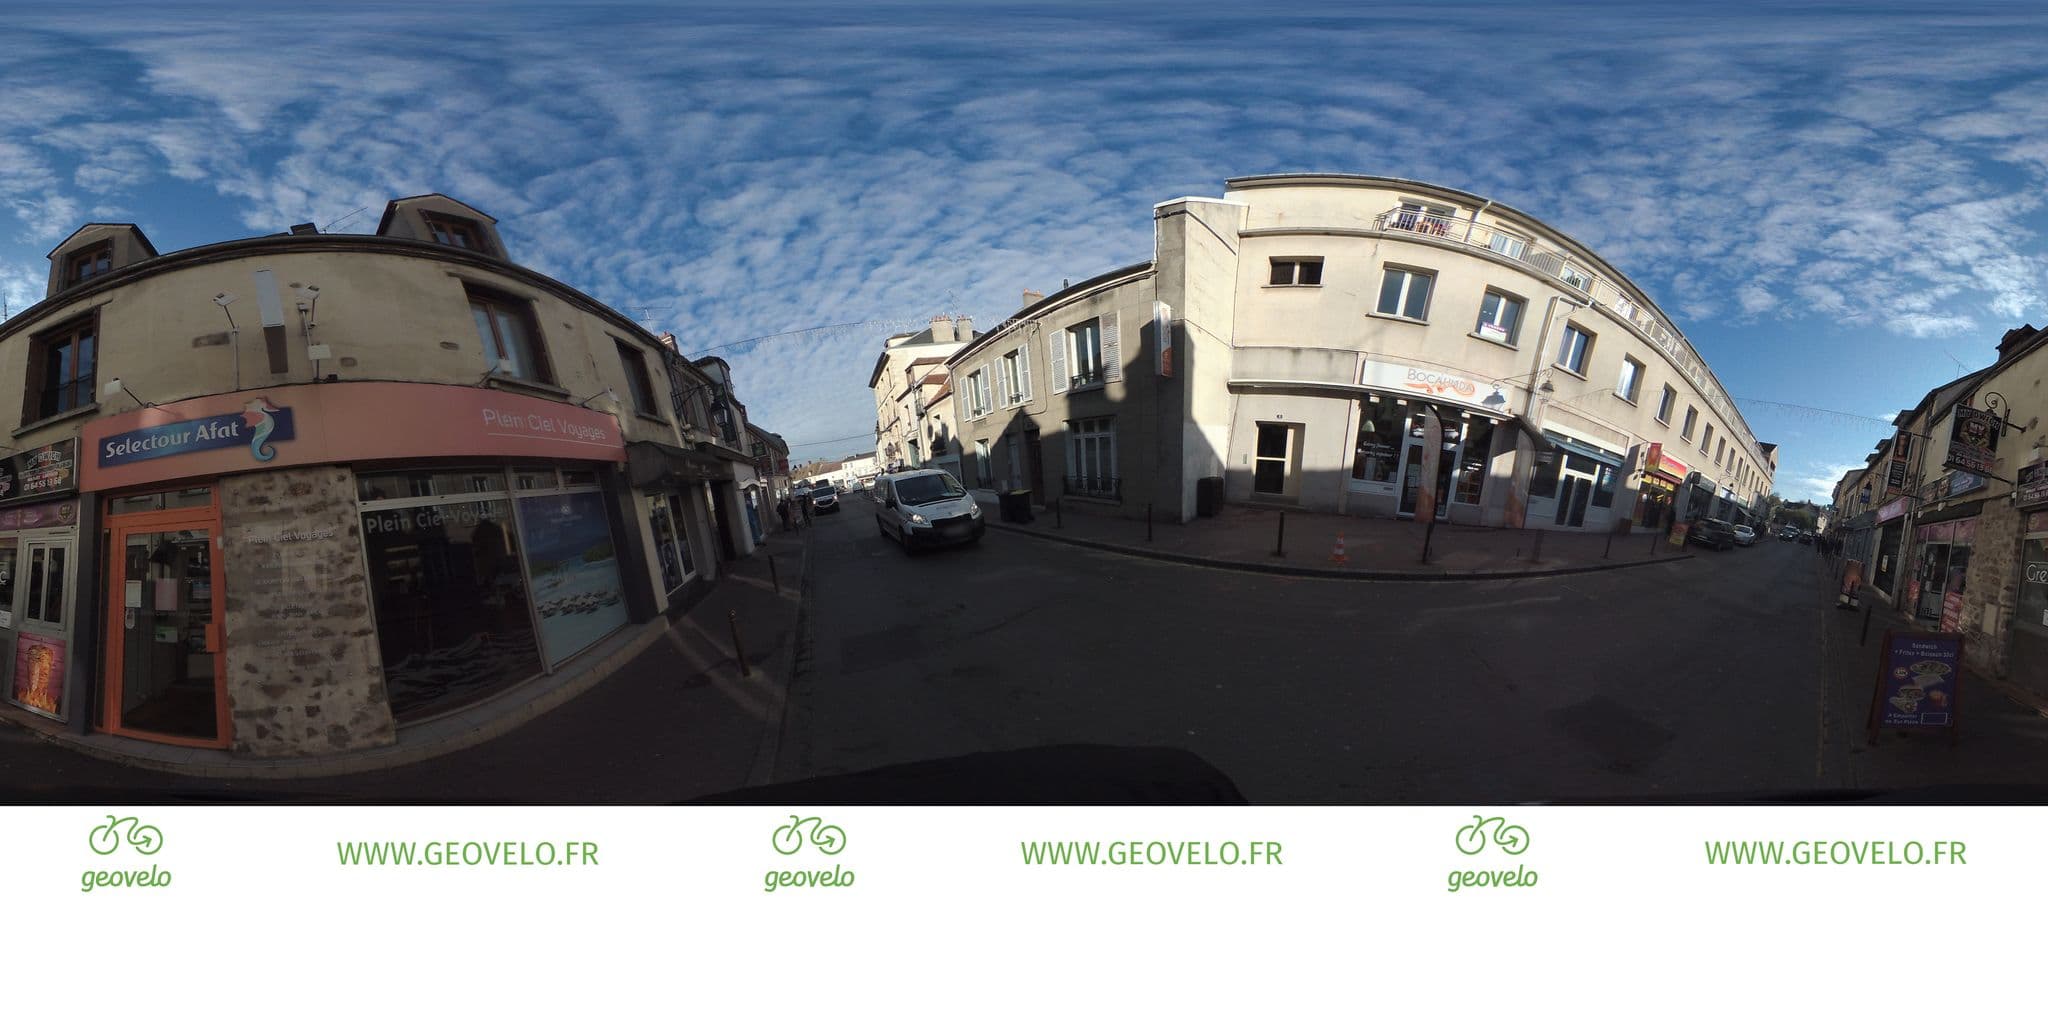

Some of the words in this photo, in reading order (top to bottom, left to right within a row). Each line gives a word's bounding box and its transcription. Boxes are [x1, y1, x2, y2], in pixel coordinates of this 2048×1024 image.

[105, 431, 191, 458] Selectour
[195, 420, 239, 442] Afat
[482, 408, 524, 428] Plein
[527, 414, 556, 432] Ciel
[557, 418, 607, 440] Voyages
[366, 514, 411, 534] Plein
